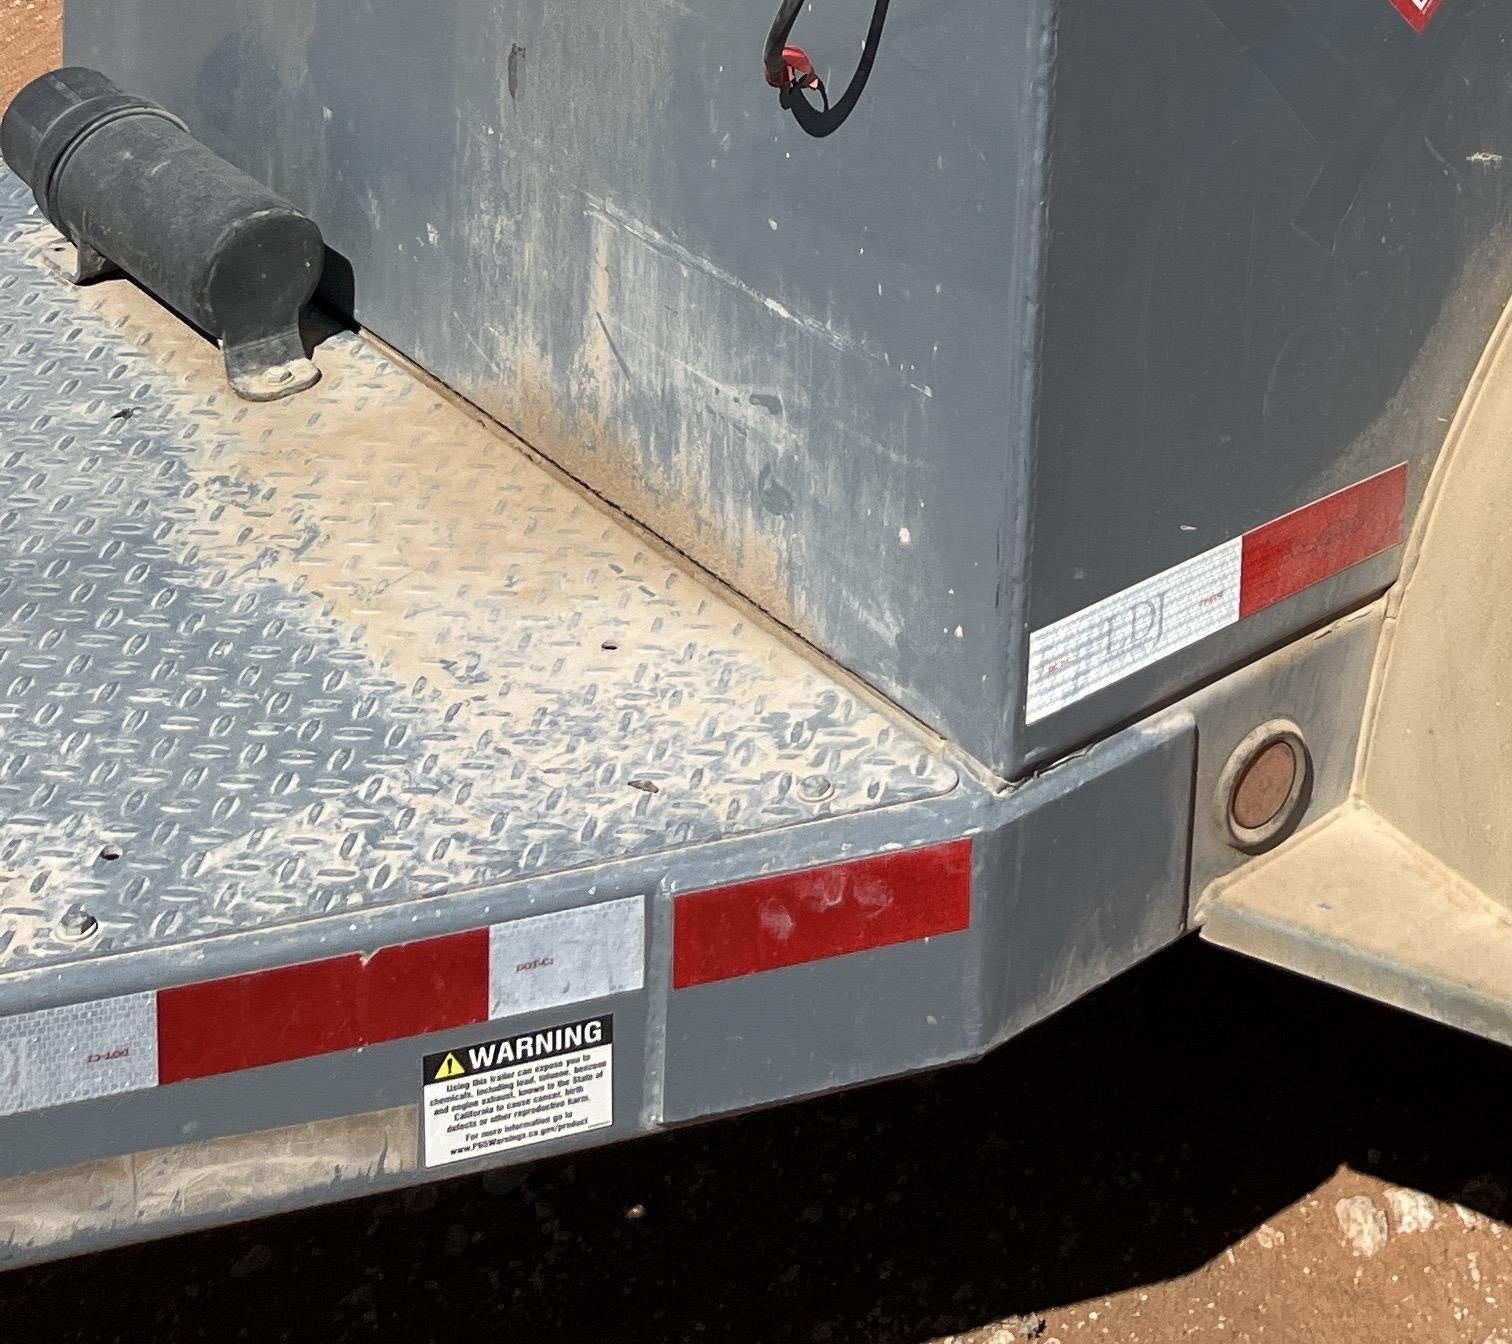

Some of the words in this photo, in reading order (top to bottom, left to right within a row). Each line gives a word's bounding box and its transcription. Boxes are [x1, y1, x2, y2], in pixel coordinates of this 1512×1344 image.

[468, 1021, 602, 1070] WARNING
[517, 1068, 532, 1077] can
[534, 1061, 563, 1075] expose
[566, 1057, 581, 1067] you
[583, 1054, 591, 1062] to
[433, 1104, 449, 1116] and
[451, 1098, 479, 1113] engine
[518, 1085, 545, 1097] known
[547, 1081, 556, 1091] to
[557, 1078, 570, 1089] the
[572, 1073, 594, 1085] State
[595, 1071, 604, 1080] of
[453, 1107, 494, 1123] California
[496, 1102, 505, 1113] to
[506, 1098, 531, 1110] cause
[564, 1085, 584, 1097] birth
[476, 1081, 515, 1096] including
[446, 1119, 477, 1133] defects
[478, 1117, 488, 1126] or
[489, 1110, 512, 1124] other
[513, 1099, 565, 1119] reproductive
[465, 1131, 478, 1142] For
[480, 1128, 503, 1139] more
[504, 1116, 551, 1133] information
[552, 1115, 563, 1126] go
[564, 1112, 573, 1121] to
